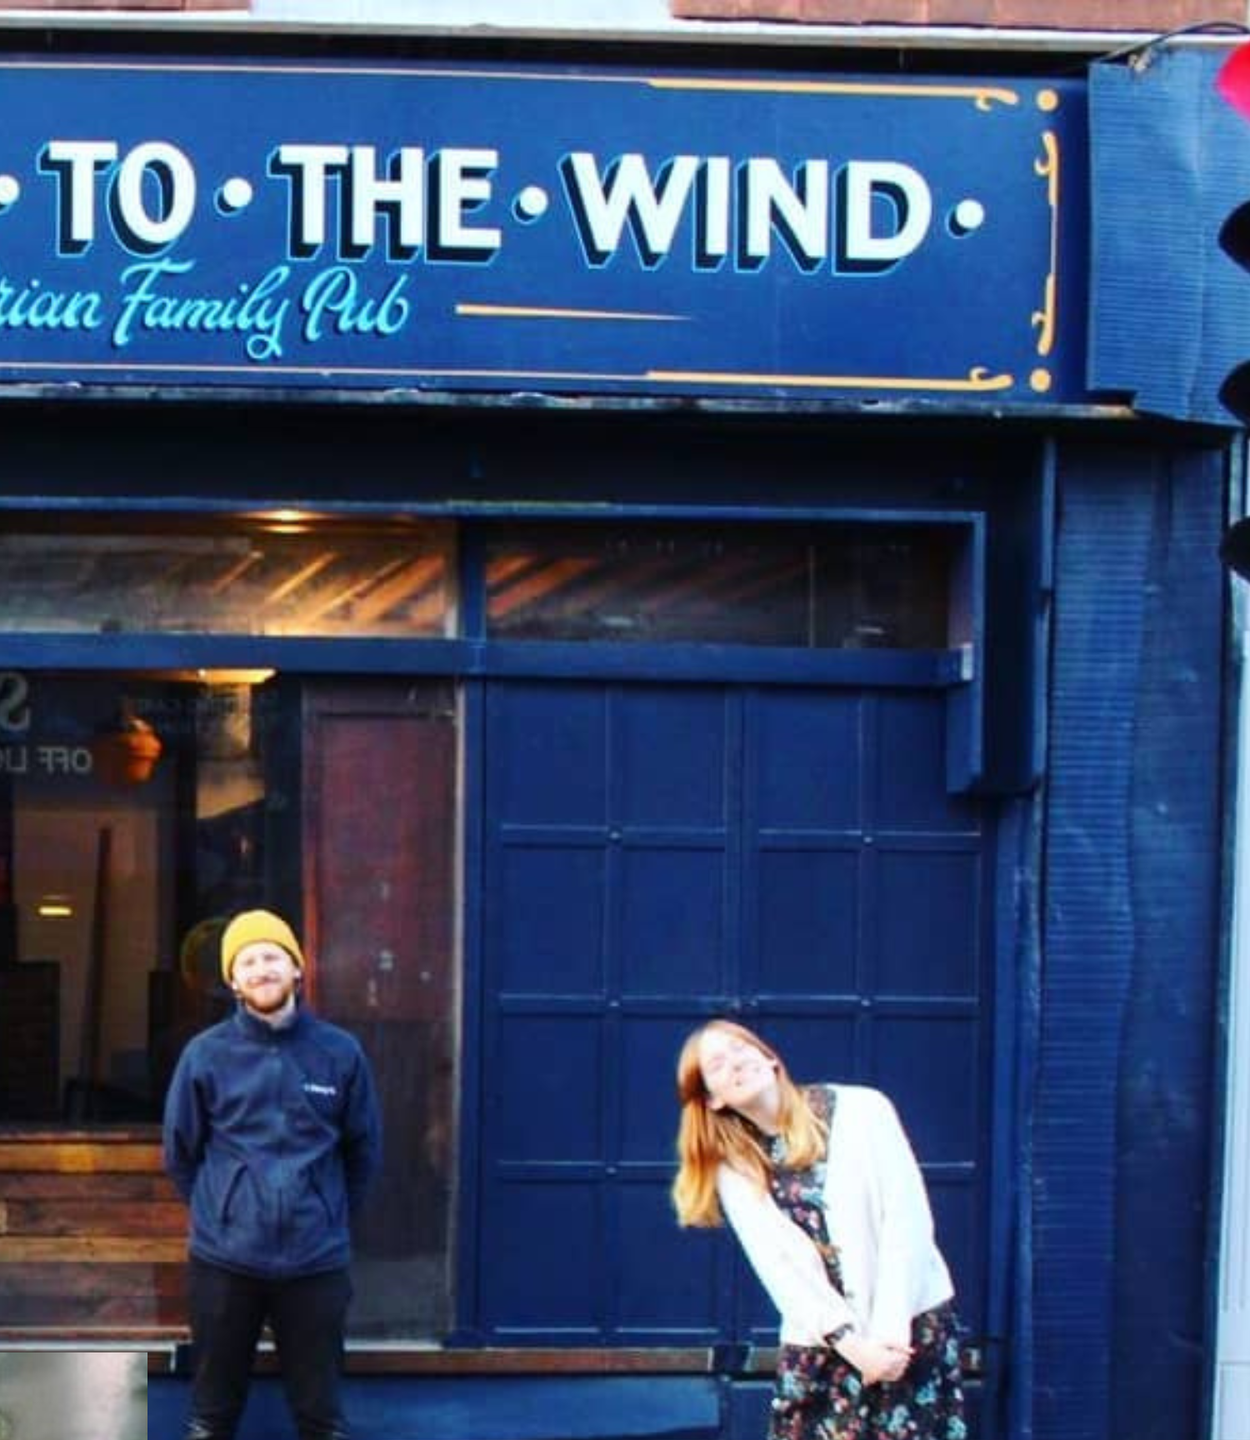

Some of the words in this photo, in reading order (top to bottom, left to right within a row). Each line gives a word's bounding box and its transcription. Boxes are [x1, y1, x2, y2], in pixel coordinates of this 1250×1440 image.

[37, 140, 197, 257] TO
[267, 145, 503, 264] THE
[557, 150, 934, 276] WIND
[111, 257, 291, 360] Family
[301, 265, 411, 344] Pub
